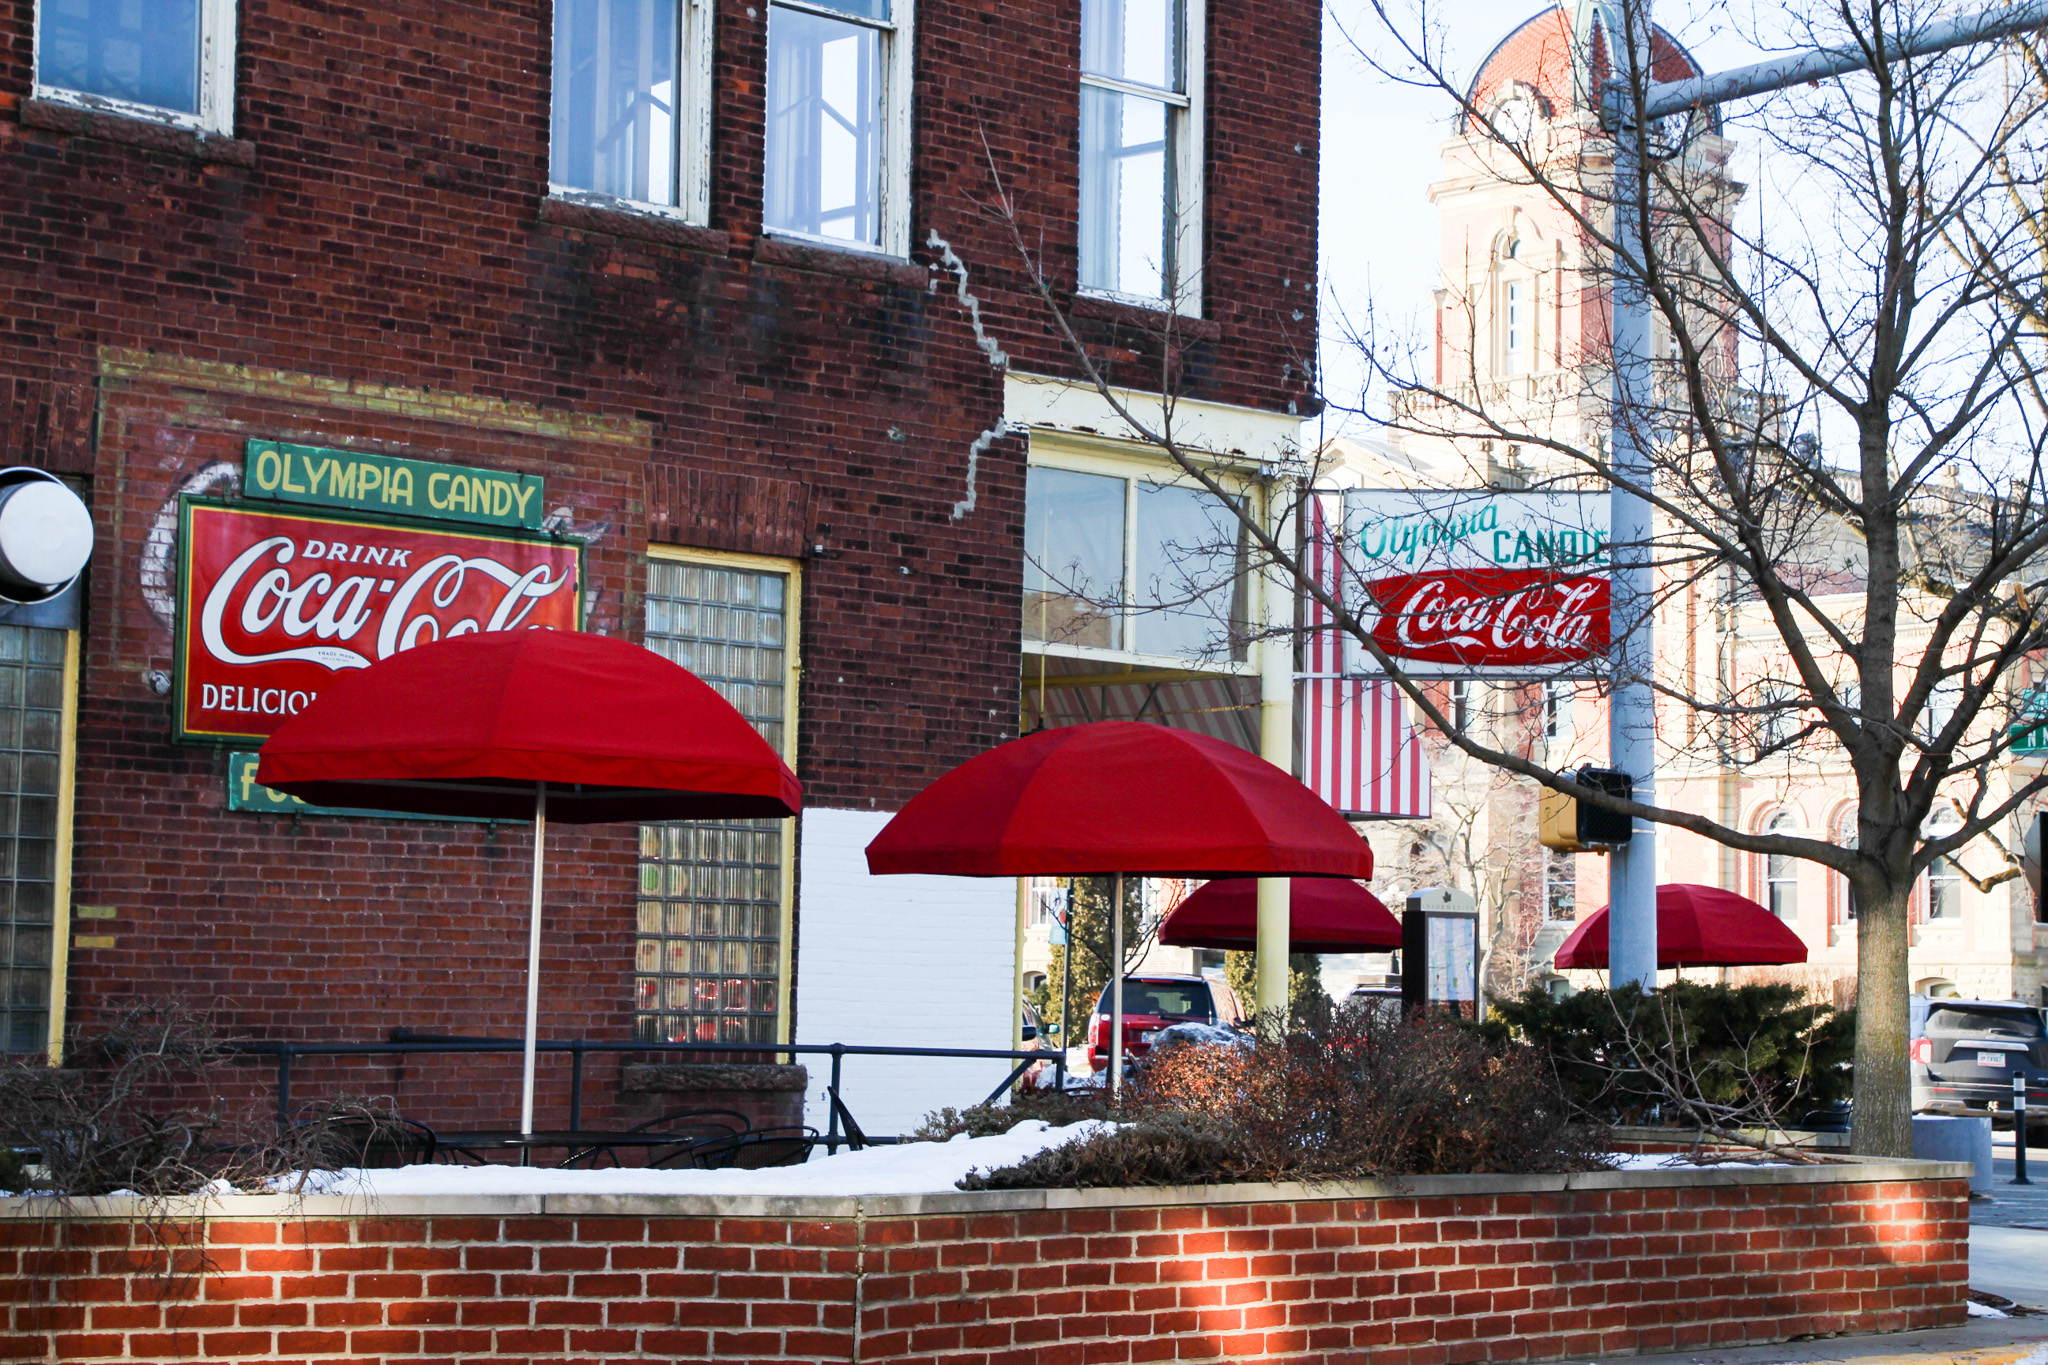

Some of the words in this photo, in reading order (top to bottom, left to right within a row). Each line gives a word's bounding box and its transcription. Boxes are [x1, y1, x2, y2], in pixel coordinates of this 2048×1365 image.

[256, 450, 413, 506] OLYMPIA
[428, 473, 535, 519] CANDY
[301, 539, 412, 568] DRINK
[1360, 503, 1500, 565] Olympia
[202, 536, 570, 671] Coca-Cl
[1397, 581, 1601, 649] Coca-Cola
[202, 683, 317, 716] DELICIO
[2028, 729, 2036, 747] N
